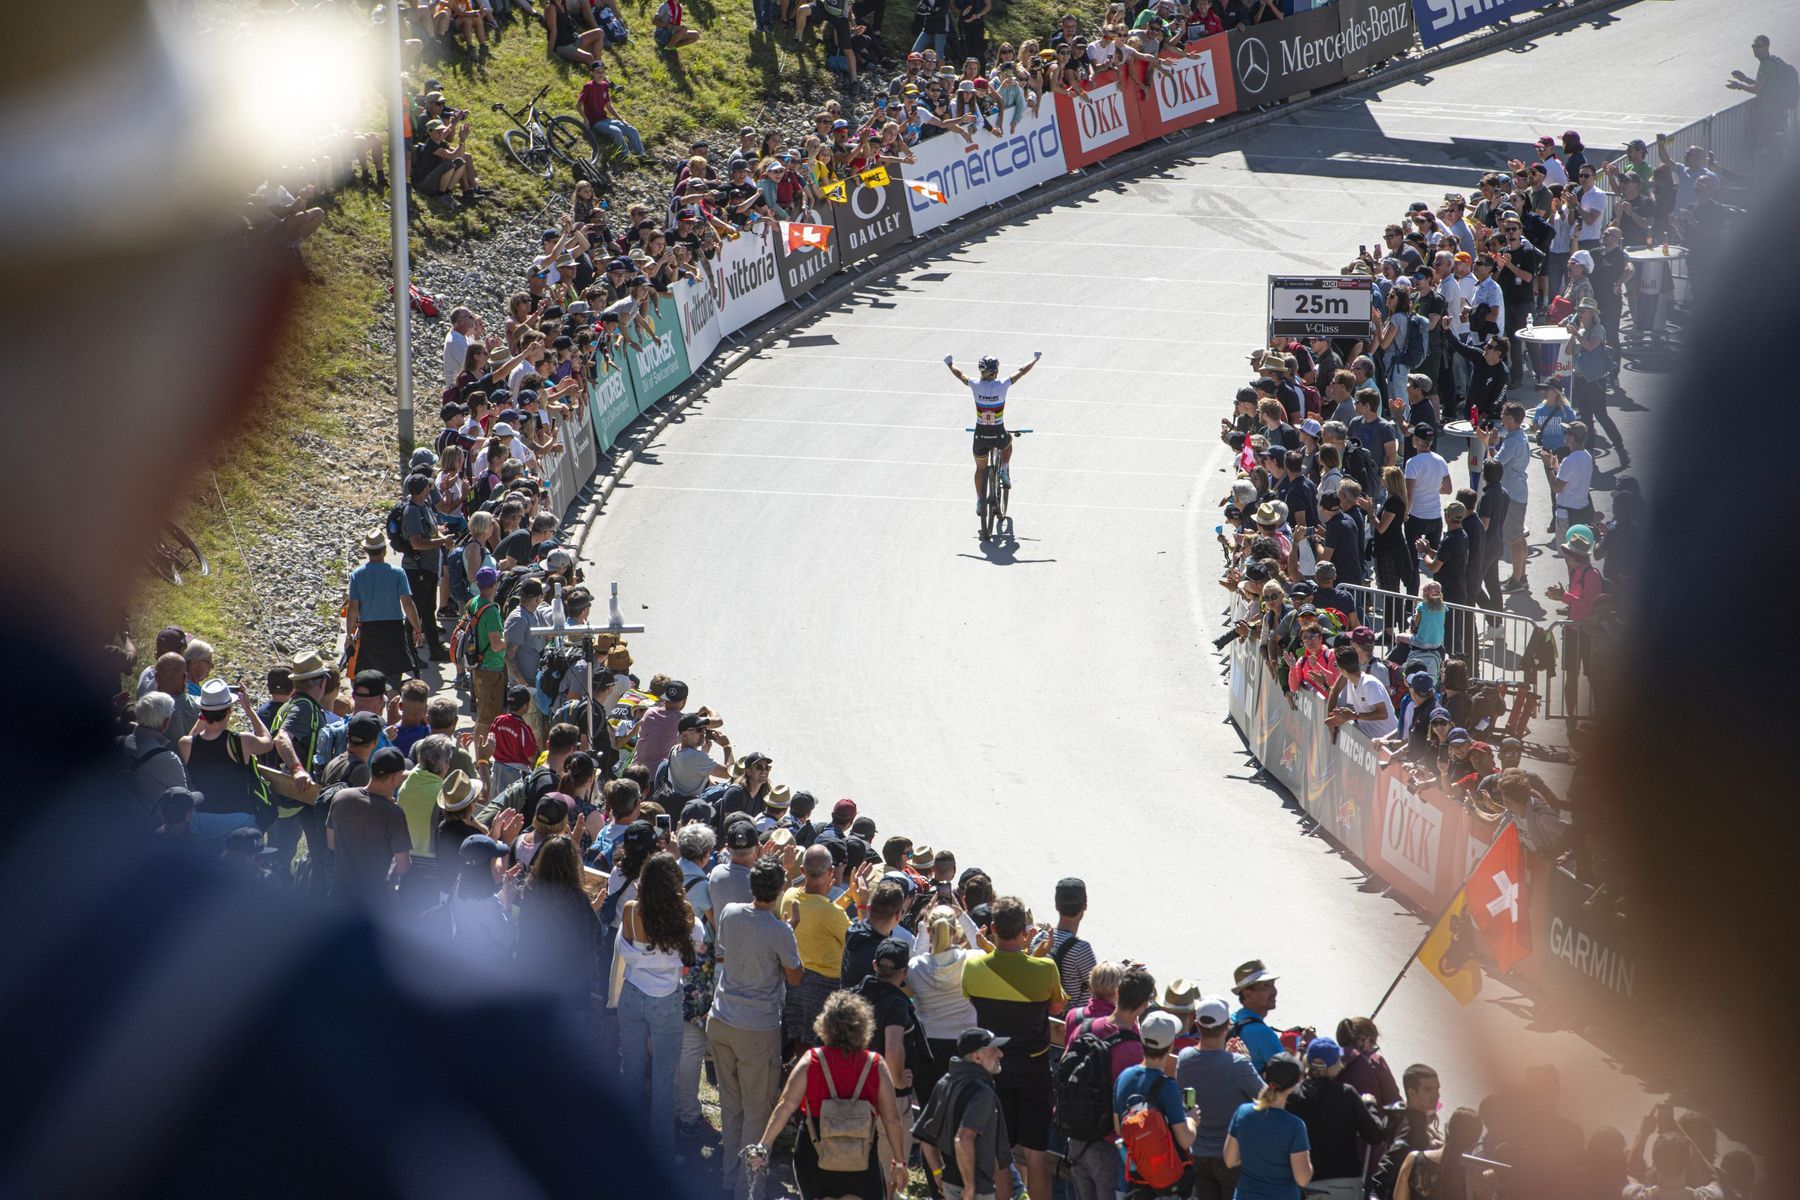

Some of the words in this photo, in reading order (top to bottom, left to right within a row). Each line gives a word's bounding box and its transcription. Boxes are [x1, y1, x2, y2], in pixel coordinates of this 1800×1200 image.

[1280, 2, 1408, 76] Mercedes-Benz
[1158, 62, 1212, 109] ÖKK
[1078, 93, 1123, 139] ÖKK
[849, 212, 901, 249] OAKLEY
[725, 246, 775, 301] vittoria
[788, 245, 834, 288] OAKLEY
[1295, 294, 1349, 315] 25m
[1305, 323, 1339, 333] V-Class
[636, 330, 676, 378] MOTOREX
[595, 372, 627, 417] MOTOREX
[1340, 728, 1365, 767] WATCH
[1365, 751, 1377, 777] ON
[1389, 788, 1436, 874] ÖKK
[1550, 916, 1635, 1000] GARMIN
